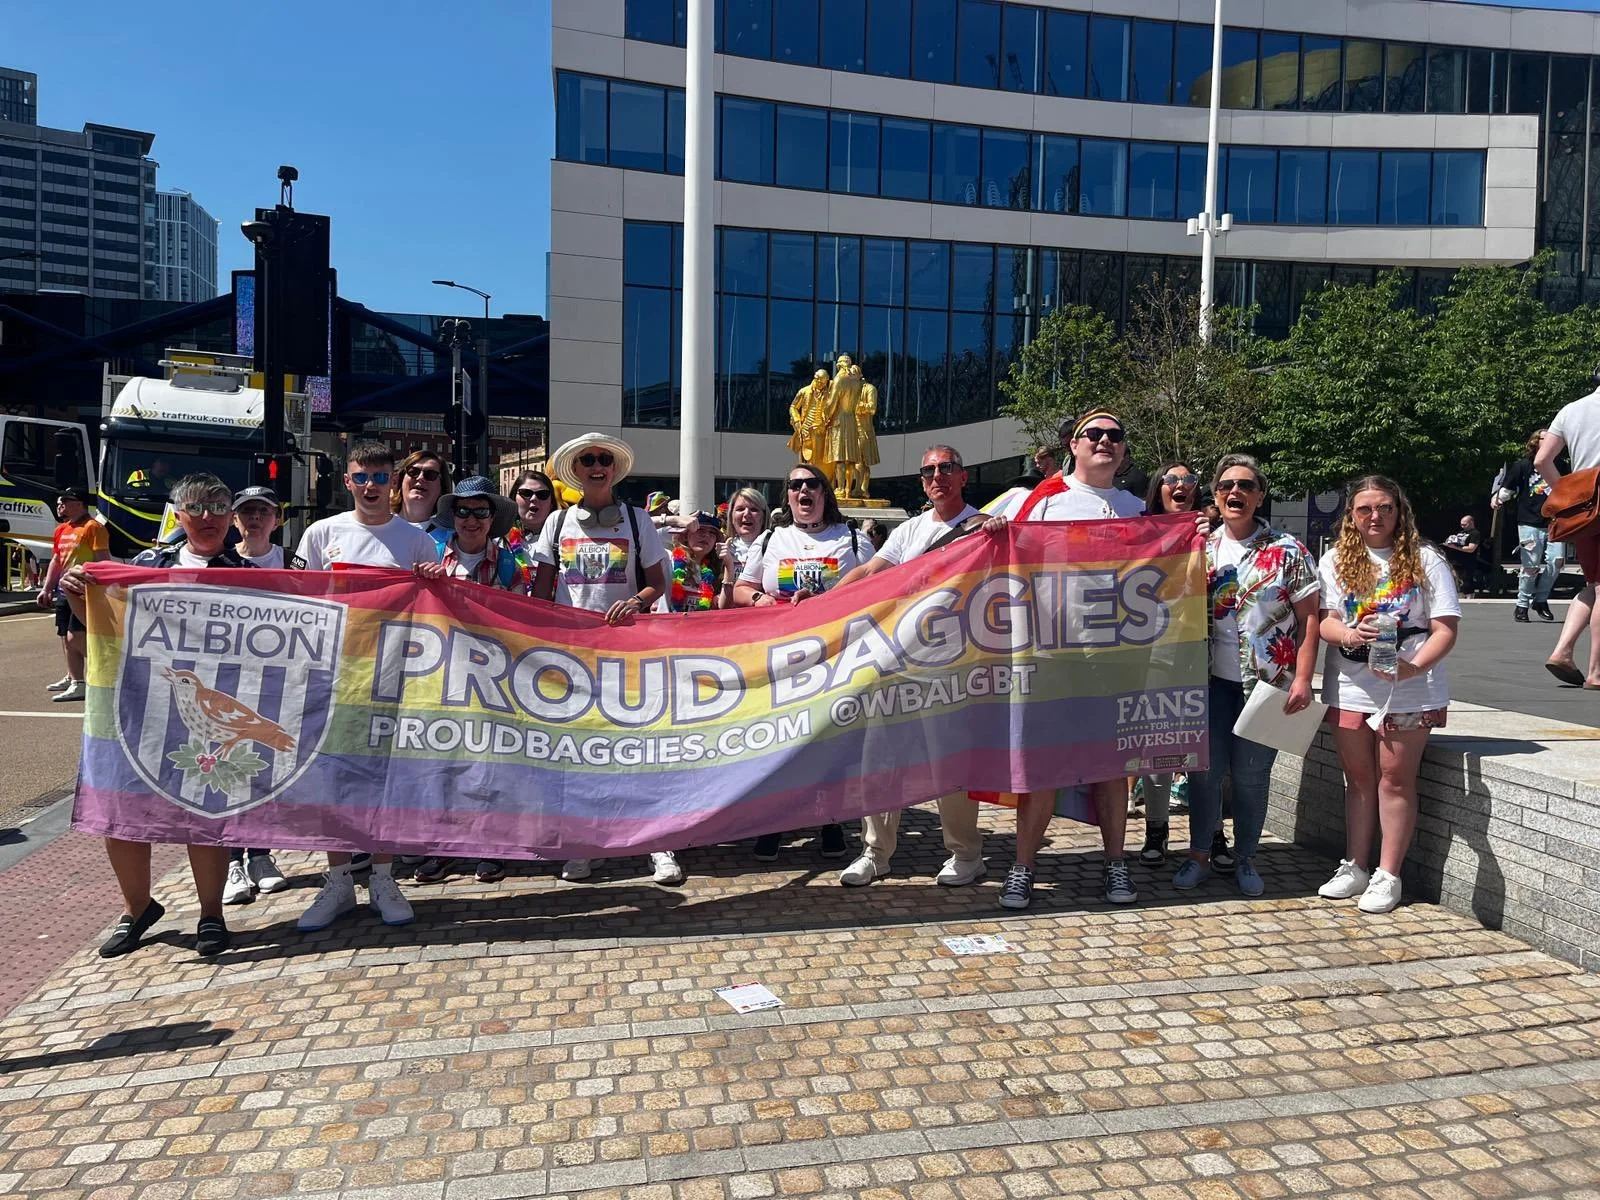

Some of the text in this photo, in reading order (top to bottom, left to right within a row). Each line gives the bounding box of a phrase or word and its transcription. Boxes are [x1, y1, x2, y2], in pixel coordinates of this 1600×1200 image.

[161, 411, 235, 424] traffixuk.com
[142, 597, 329, 627] WEST BROMWICH
[137, 616, 326, 663] ALBION
[371, 565, 1170, 728] PROUD BAGGIES
[368, 663, 1037, 767] PROUDBAGGIES.COM @WBALGBT
[1116, 689, 1206, 724] FANS
[1116, 730, 1205, 751] DIVERSITY
[1150, 721, 1170, 731] FOR
